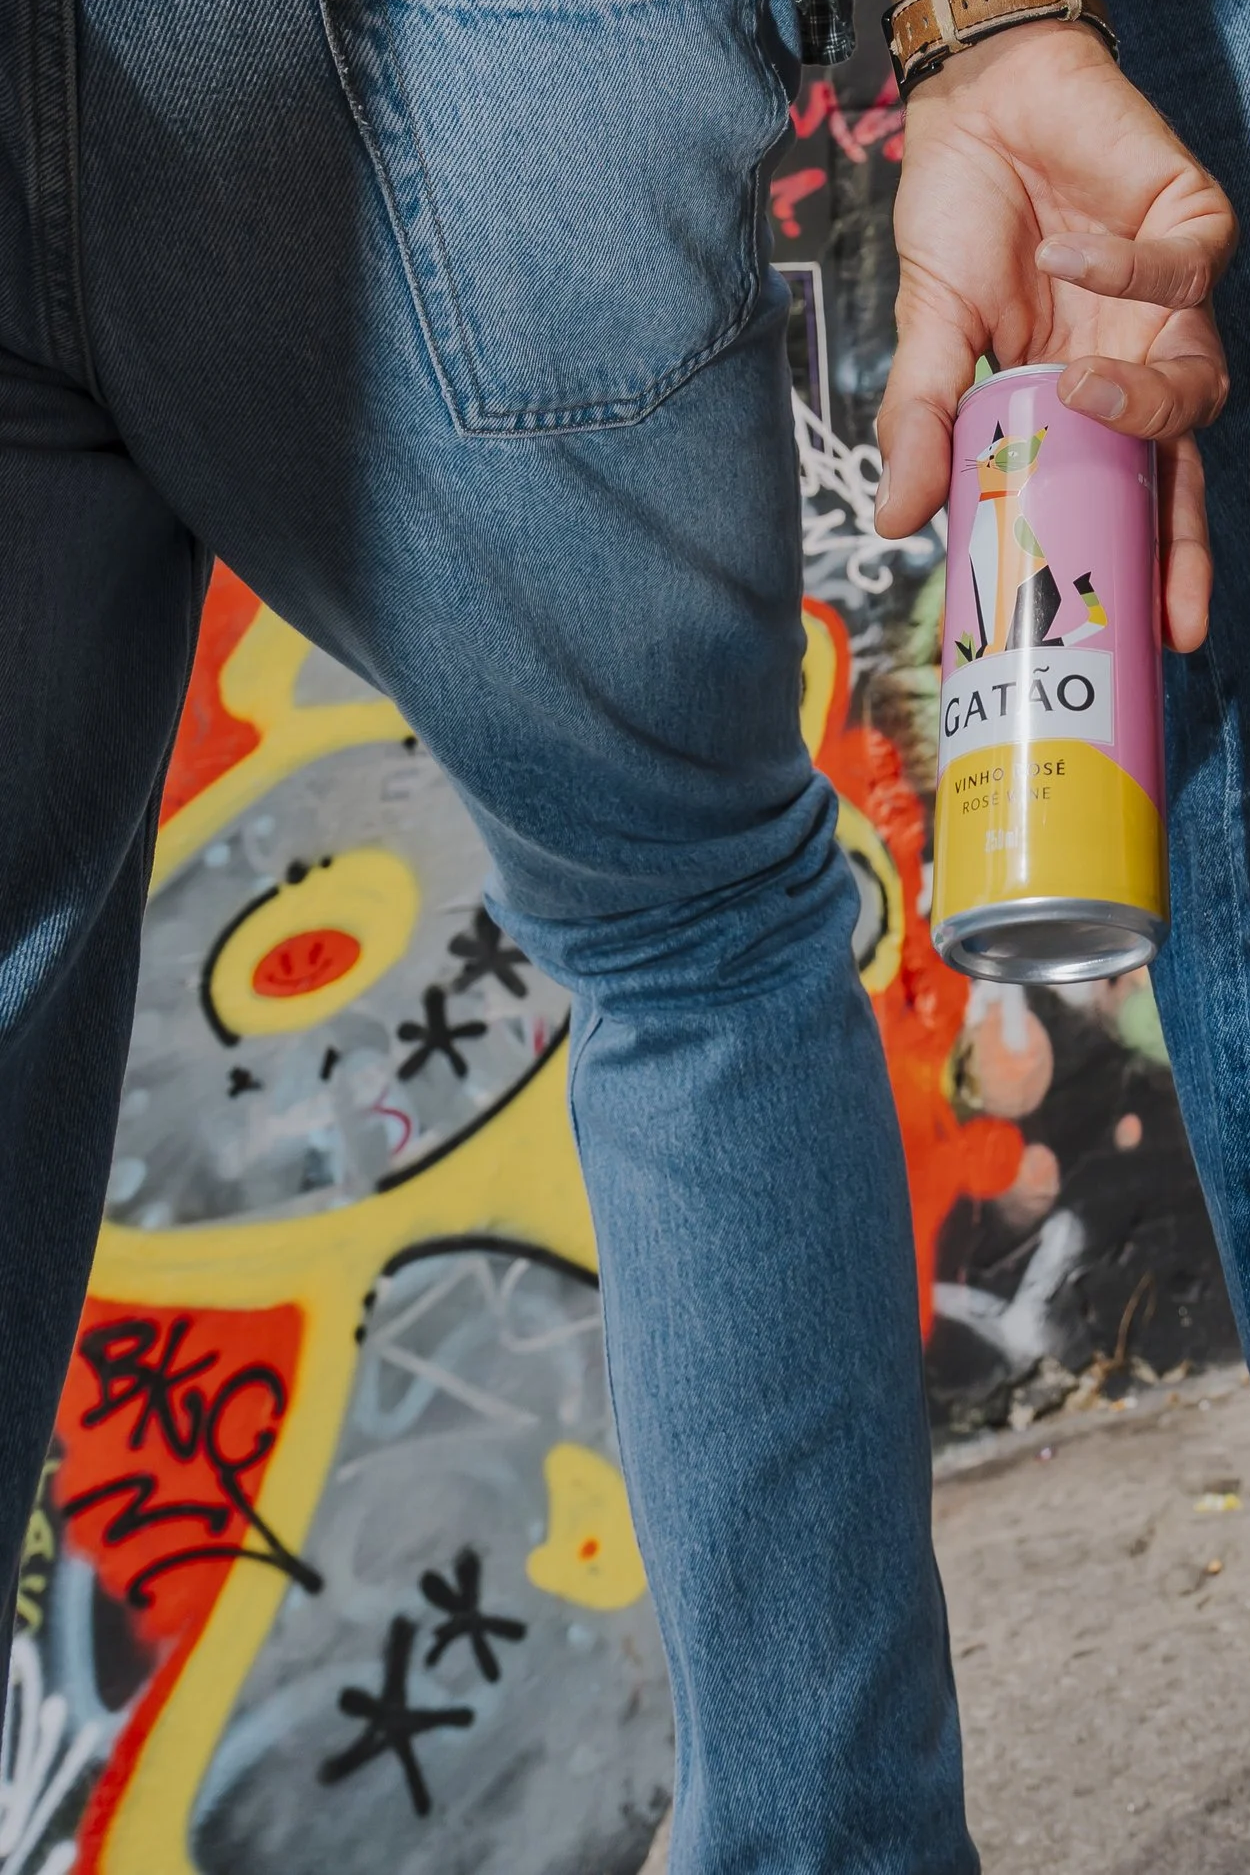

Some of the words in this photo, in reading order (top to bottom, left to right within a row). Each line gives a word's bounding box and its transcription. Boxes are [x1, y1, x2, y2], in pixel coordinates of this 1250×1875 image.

[944, 666, 1095, 738] GATÃO
[954, 767, 1005, 795] VINHO
[1014, 759, 1066, 778] OSÉ
[962, 790, 999, 815] ROSÉ
[1006, 786, 1052, 803] WNE
